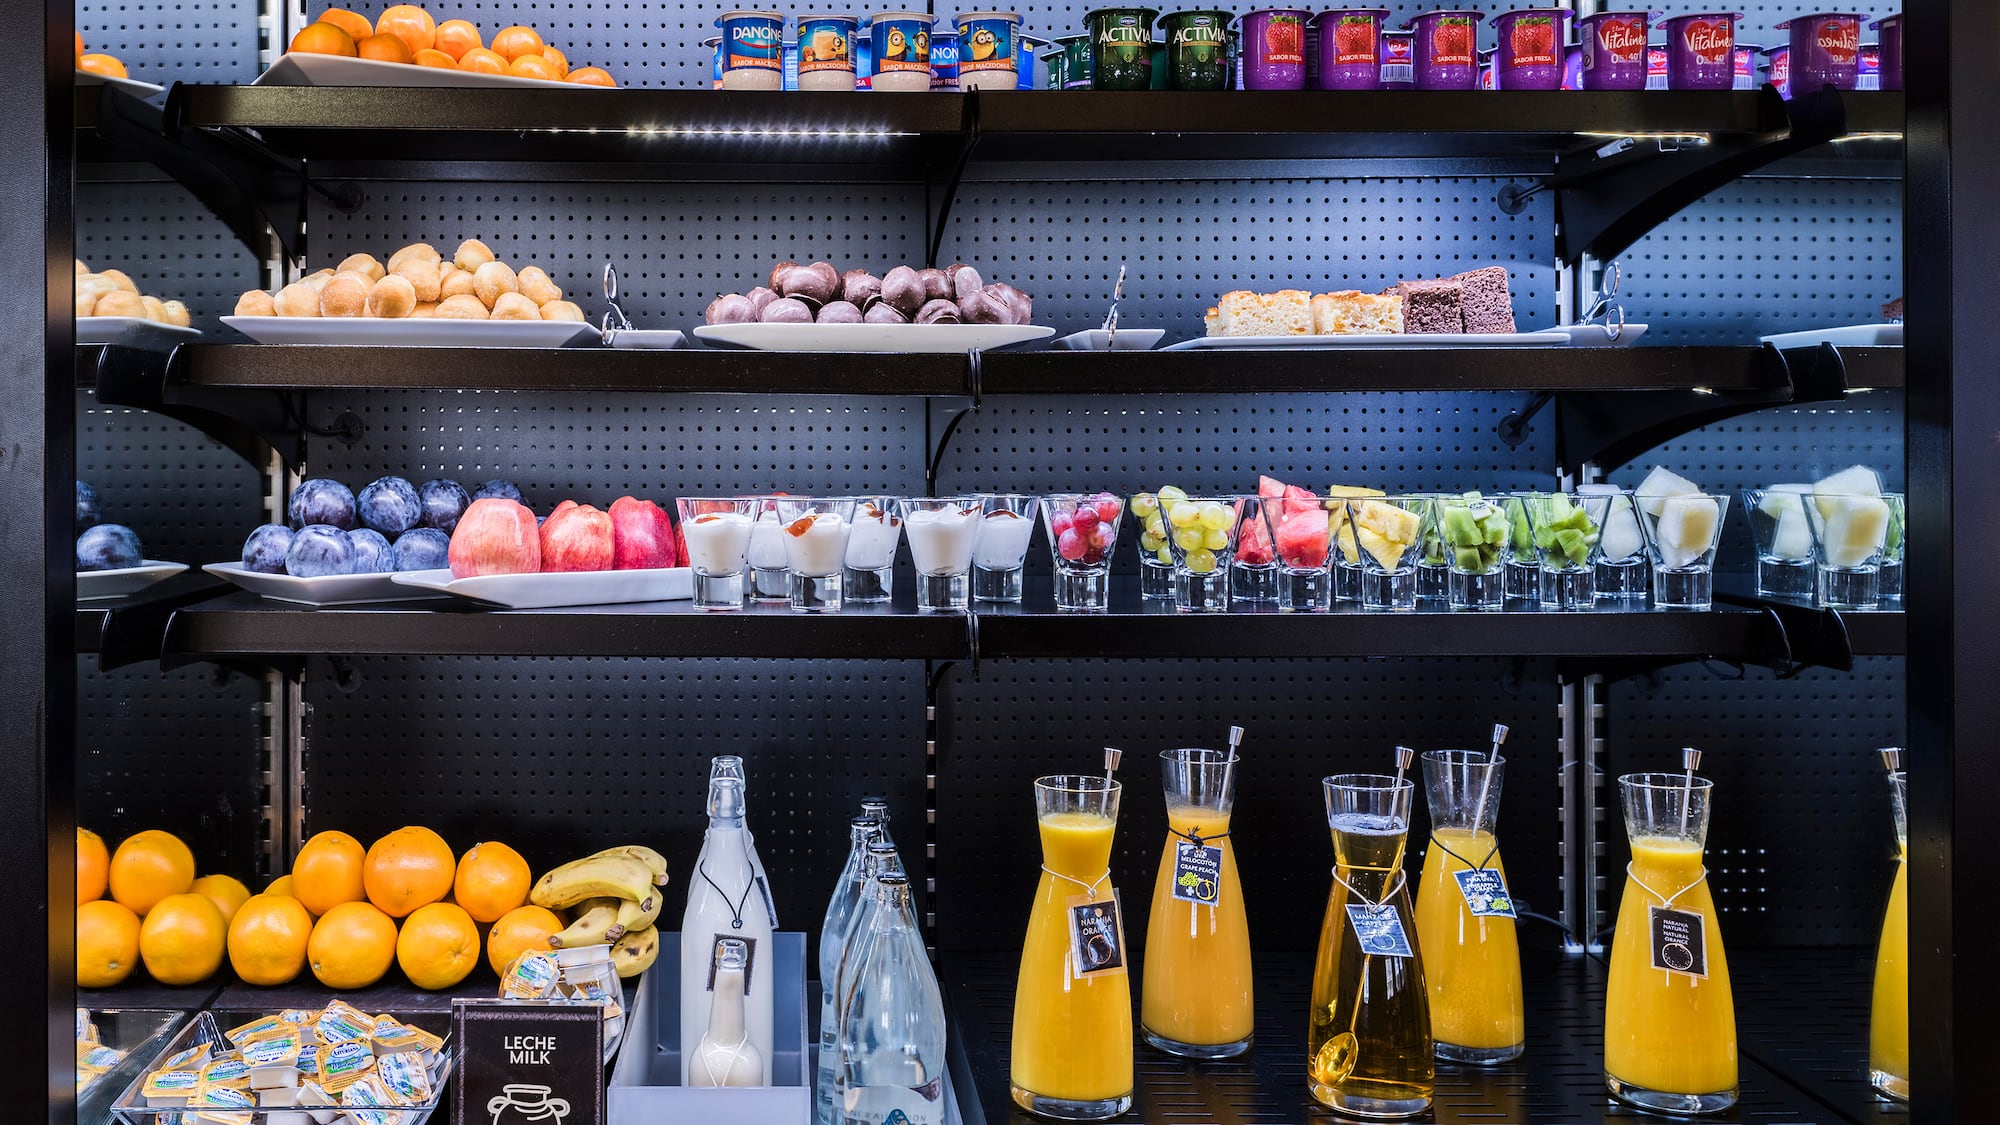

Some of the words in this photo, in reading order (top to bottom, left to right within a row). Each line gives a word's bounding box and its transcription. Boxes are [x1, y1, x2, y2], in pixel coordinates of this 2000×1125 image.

[733, 26, 782, 42] DANONE
[1098, 27, 1152, 44] ACTIVIA
[1173, 27, 1227, 44] ACTIVIA
[1436, 55, 1457, 63] SABOR
[1513, 56, 1534, 64] SABOR
[1663, 919, 1689, 928] NARANJA
[1662, 924, 1690, 934] NATURAL
[1662, 931, 1690, 941] NATURAL
[1664, 937, 1689, 946] ORANGE
[504, 1036, 557, 1050] LECHE
[509, 1051, 551, 1064] MILK
